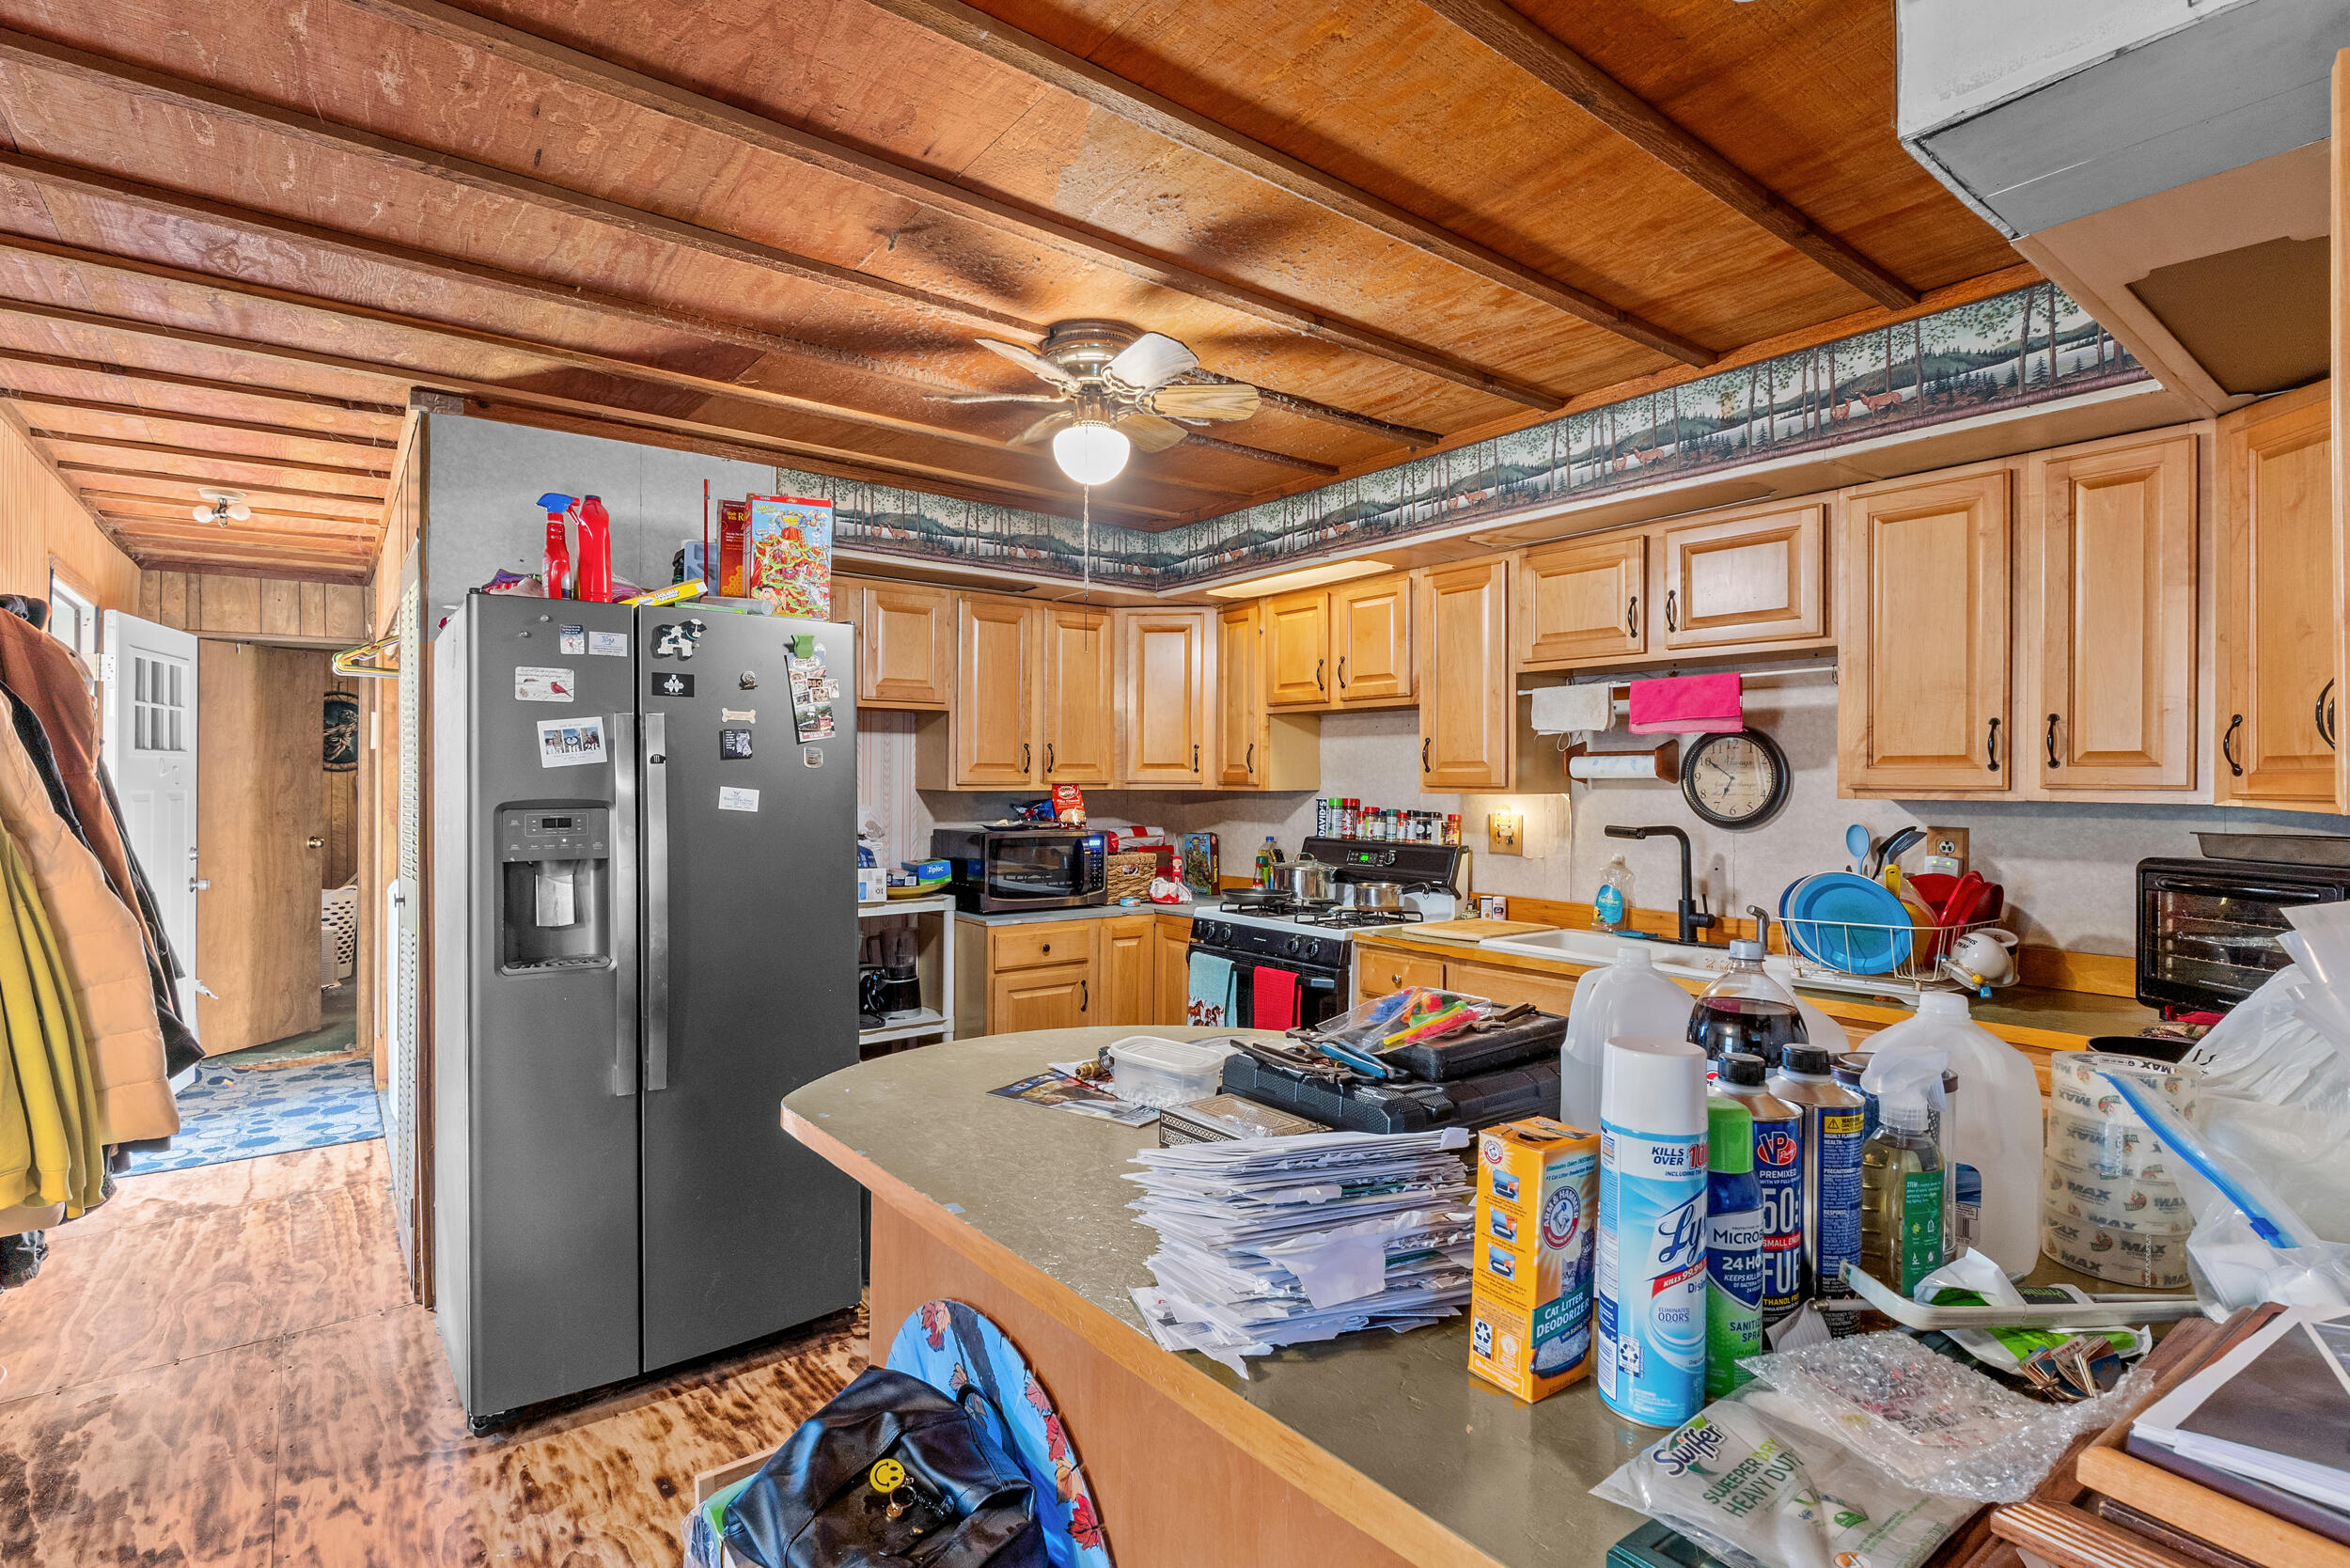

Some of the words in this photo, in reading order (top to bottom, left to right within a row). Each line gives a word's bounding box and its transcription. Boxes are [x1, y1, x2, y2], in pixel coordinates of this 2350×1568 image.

[1712, 745, 1722, 754] 11
[1748, 744, 1753, 753] 1
[1694, 773, 1701, 782] 9
[1700, 790, 1707, 799] 8
[1714, 801, 1720, 811] 7
[1730, 805, 1737, 816] 6
[1747, 802, 1753, 812] 5
[1318, 801, 1326, 837] DAVID'S
[928, 866, 944, 874] Ziploc
[2139, 1061, 2171, 1074] MAX
[1652, 1147, 1684, 1157] KILLS
[1653, 1156, 1684, 1166] OVER
[1760, 1168, 1797, 1179] PREMIXED
[2068, 1181, 2111, 1200] MAX
[1543, 1201, 1555, 1227] ARM
[1553, 1195, 1559, 1203] &
[1559, 1189, 1579, 1218] HAMMER
[2089, 1213, 2138, 1230] MAX
[1714, 1228, 1762, 1245] MICROB
[1762, 1237, 1788, 1247] SMALL
[2121, 1240, 2166, 1254] MAX
[1722, 1258, 1743, 1271] 24
[1747, 1254, 1762, 1269] HO
[2061, 1251, 2103, 1273] MAX
[1724, 1274, 1745, 1282] KEEPS
[1747, 1271, 1762, 1280] KILLIN
[1762, 1248, 1799, 1294] FUE
[1663, 1276, 1683, 1288] KILLS
[1545, 1304, 1559, 1320] CAT
[1561, 1292, 1583, 1312] LITTER
[1762, 1297, 1790, 1307] THANOL
[1536, 1297, 1590, 1338] DEODORIZER
[1658, 1312, 1690, 1322] ODORS
[1742, 1330, 1762, 1342] SPRA
[1653, 1421, 1726, 1476] Swiffer
[1702, 1457, 1763, 1504] SWEEPER
[1752, 1436, 1782, 1462] DRY
[1722, 1478, 1776, 1518] HEAVY
[1763, 1449, 1805, 1482] DUTY
